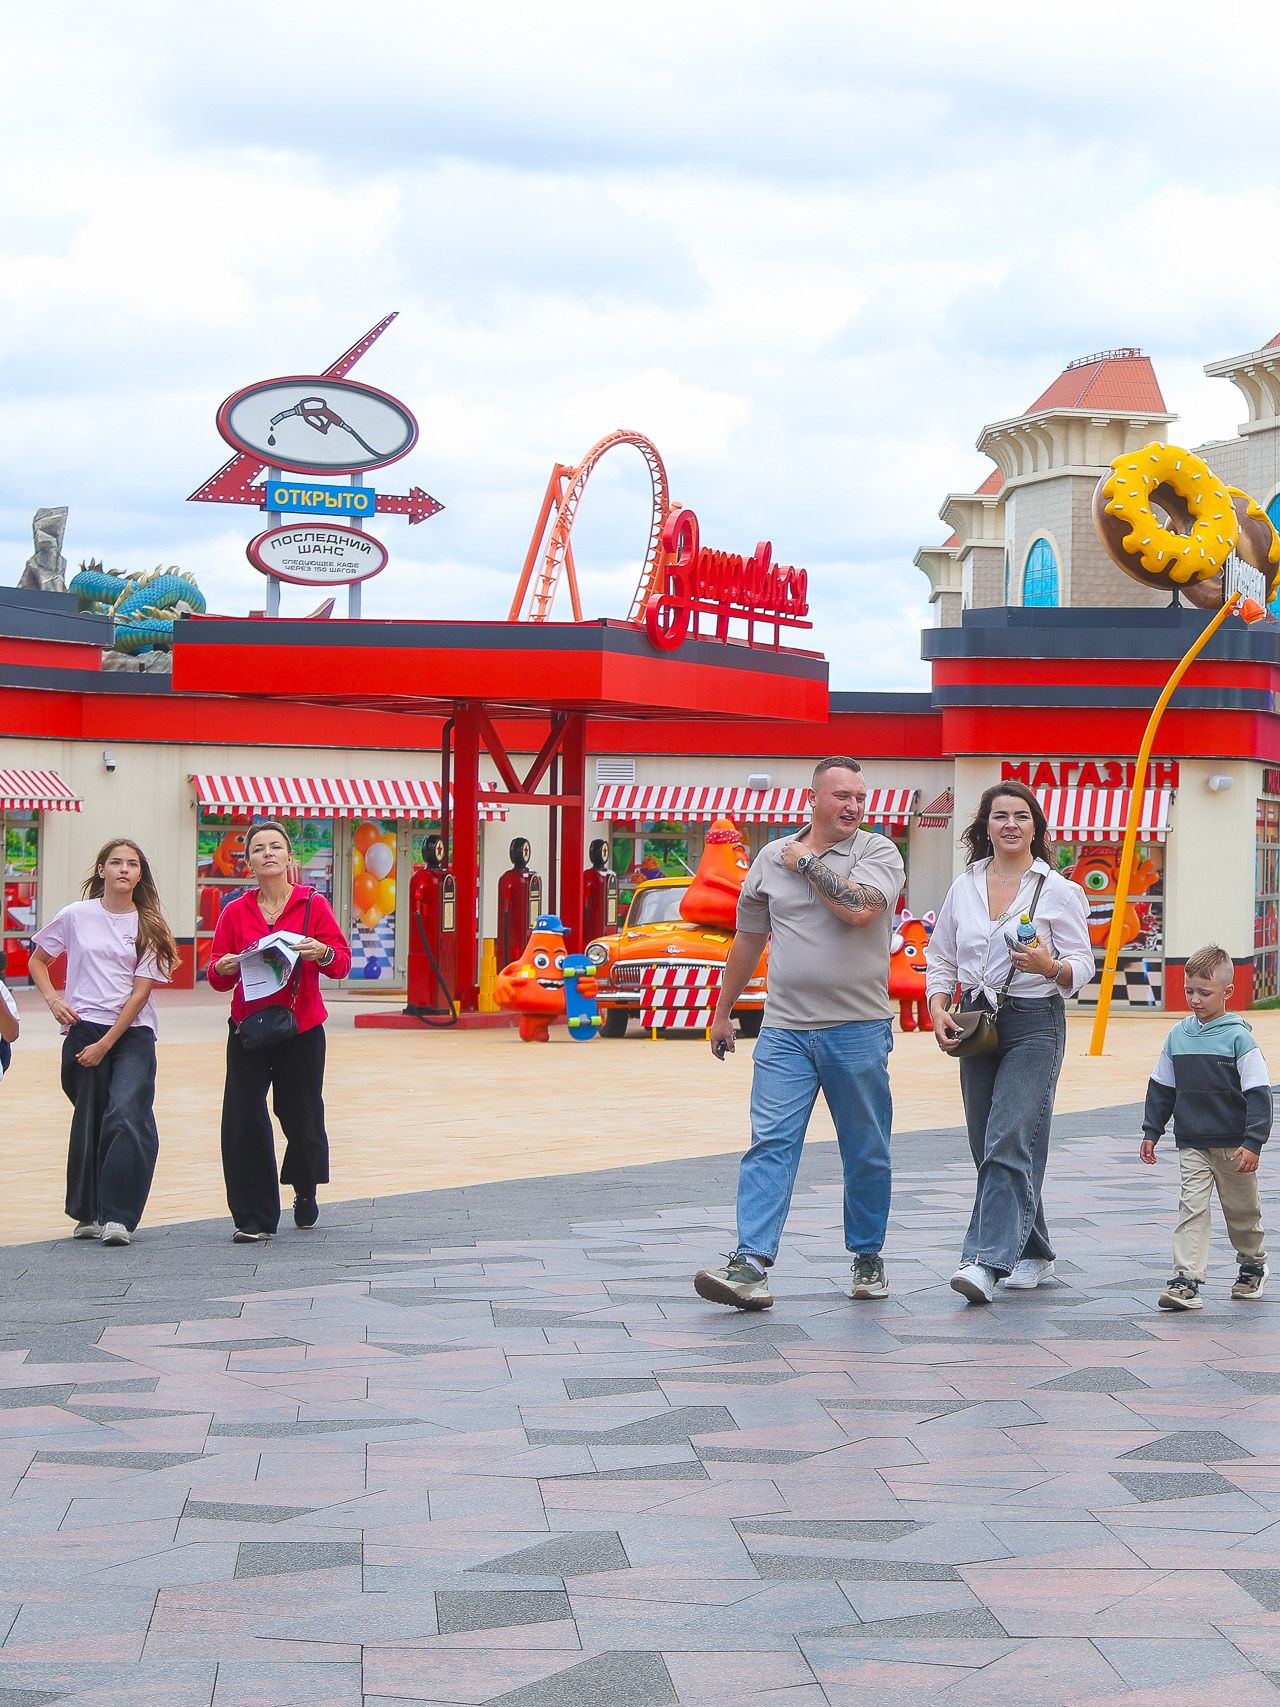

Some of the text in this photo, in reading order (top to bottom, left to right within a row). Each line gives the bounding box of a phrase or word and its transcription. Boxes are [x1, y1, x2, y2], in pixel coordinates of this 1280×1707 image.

[274, 488, 368, 509] ОТКРЫТО
[270, 533, 372, 555] ПОСЛЕДНИЙ
[298, 544, 345, 556] ШАНС
[282, 559, 335, 567] СЛЕДУЮЩЕЕ
